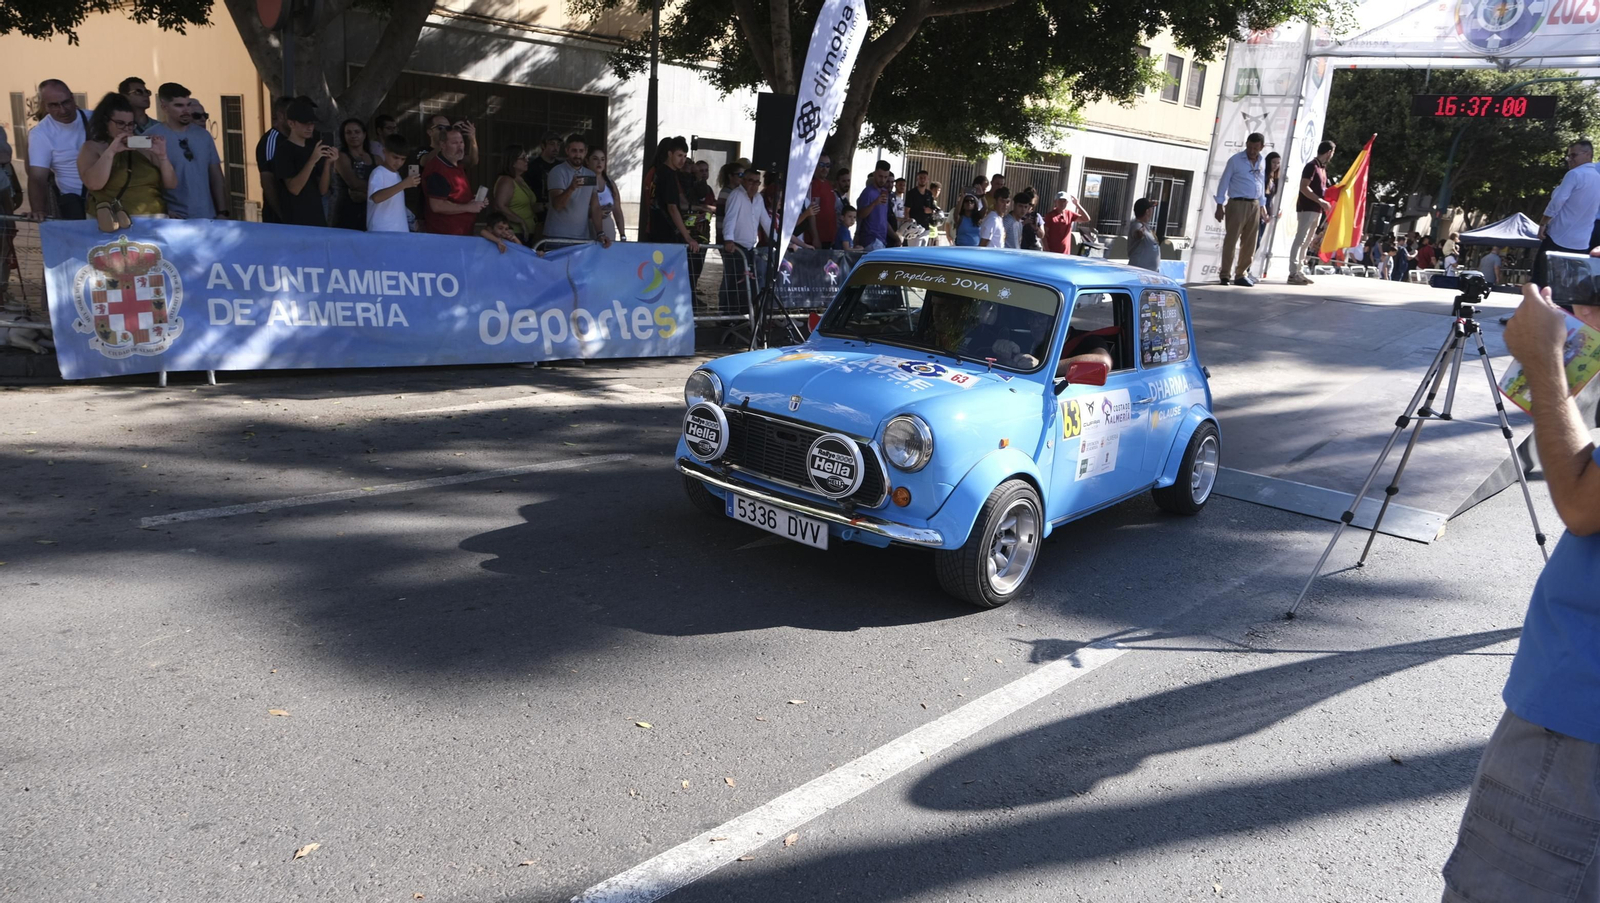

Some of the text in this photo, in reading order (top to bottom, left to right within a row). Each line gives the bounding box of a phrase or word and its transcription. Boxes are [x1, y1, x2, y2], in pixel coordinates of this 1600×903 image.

[1546, 0, 1600, 25] 2023
[813, 5, 854, 97] dimoba
[1435, 96, 1528, 118] 16:37:00
[1223, 140, 1275, 149] CUA
[206, 263, 460, 298] AYUNTAMIENTO
[893, 270, 990, 294] Papelería JOYA
[207, 297, 410, 328] DE ALMERÍA
[478, 300, 678, 355] deportes
[950, 373, 970, 384] 63
[1147, 374, 1190, 403] DHARMA
[1063, 400, 1082, 438] 63
[1158, 405, 1182, 421] CLAUSE
[688, 423, 717, 442] Hella
[813, 456, 851, 478] Hella
[817, 448, 854, 464] Rallye 3000
[738, 498, 821, 545] 5336 DVV
